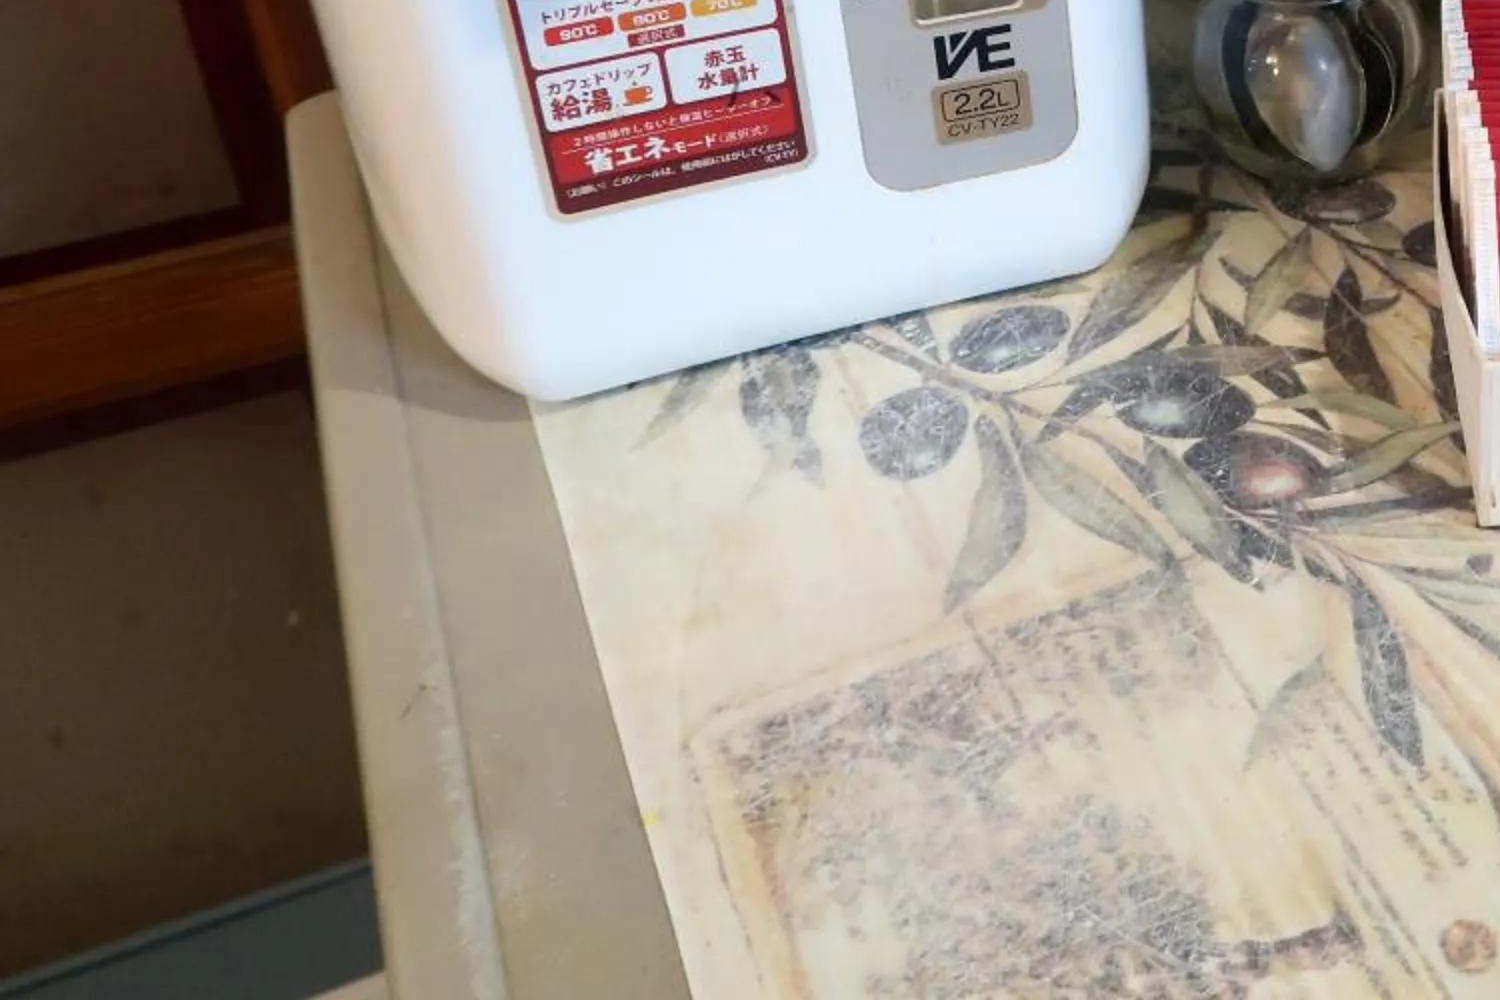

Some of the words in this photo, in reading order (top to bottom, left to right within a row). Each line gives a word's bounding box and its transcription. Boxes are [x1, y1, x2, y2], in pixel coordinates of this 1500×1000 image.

[703, 44, 747, 68] 赤玉
[546, 62, 653, 97] カフェドリップ
[697, 63, 761, 92] 水量計
[550, 88, 615, 123] 給湯
[953, 87, 1008, 117] 2.2L
[947, 112, 1020, 139] CV-TY22
